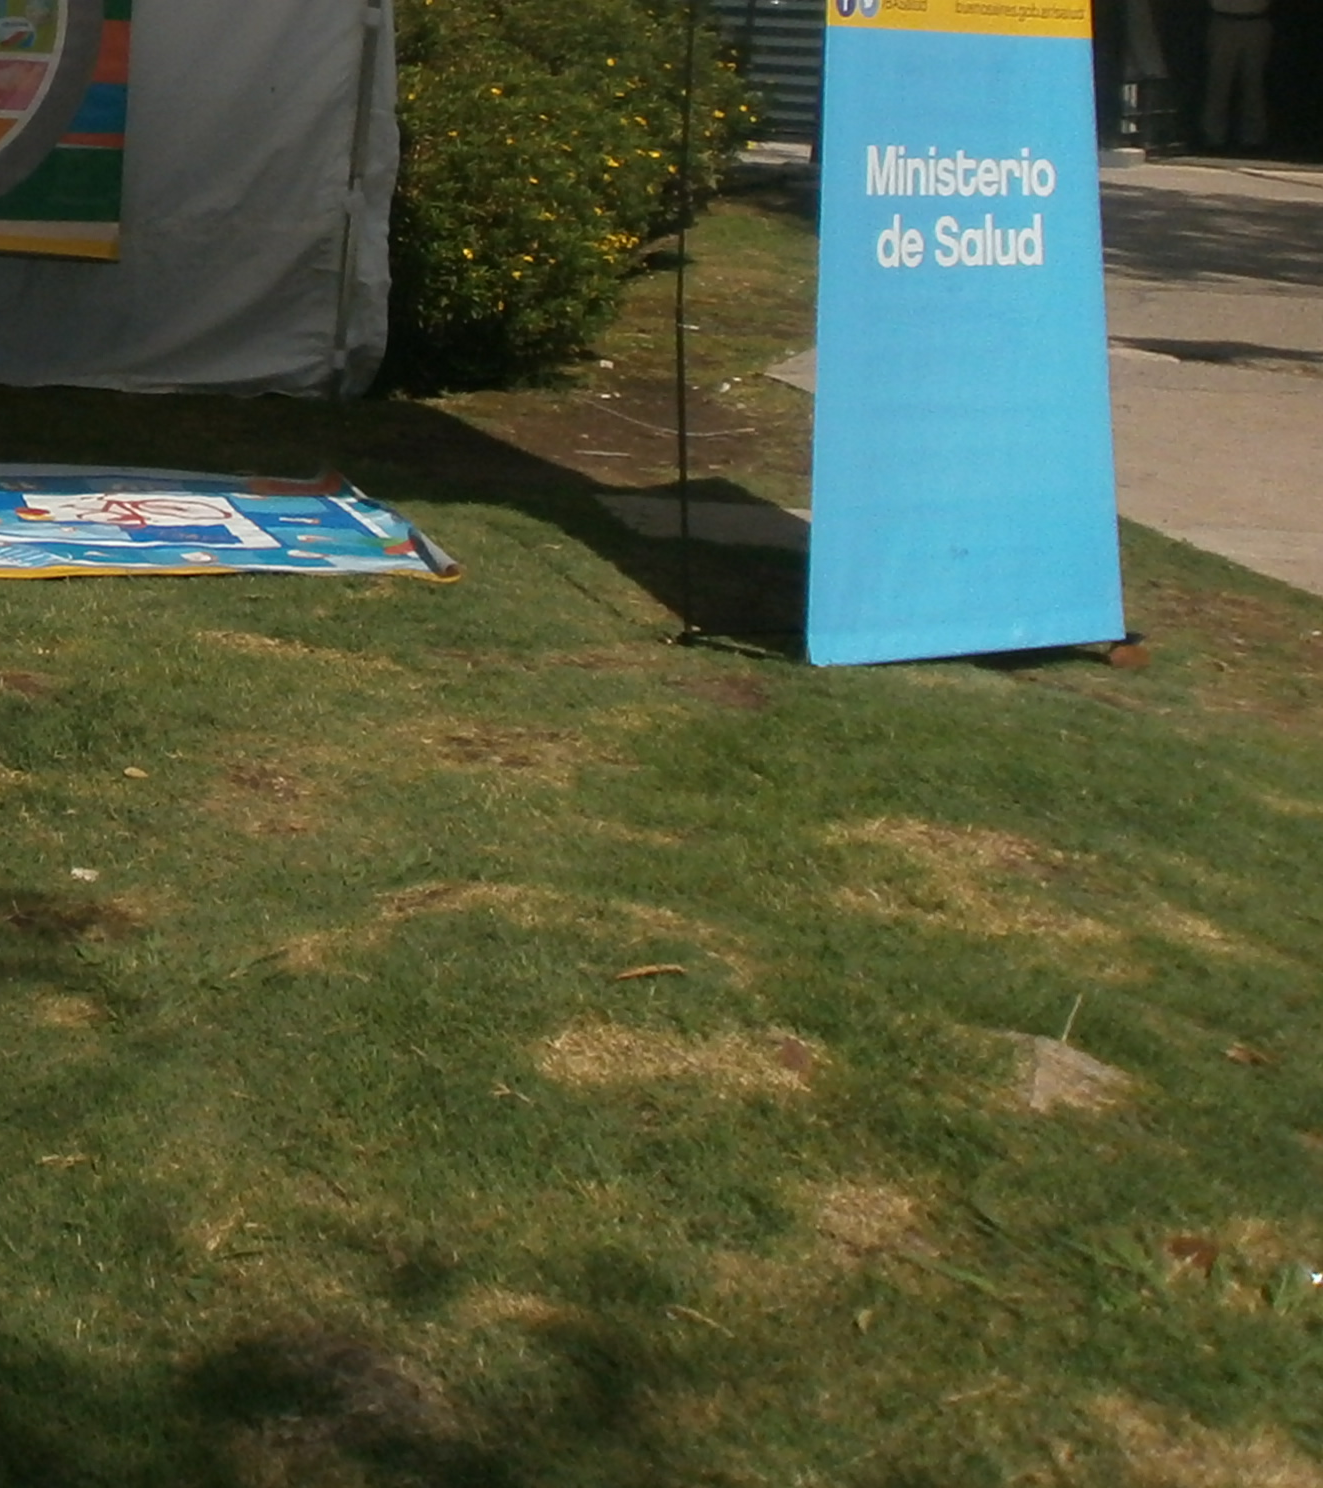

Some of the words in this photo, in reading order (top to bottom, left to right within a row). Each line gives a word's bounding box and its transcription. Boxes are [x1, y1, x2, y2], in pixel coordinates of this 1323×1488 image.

[866, 145, 1055, 197] Ministerio
[876, 214, 924, 268] de
[935, 214, 1044, 267] Salud
